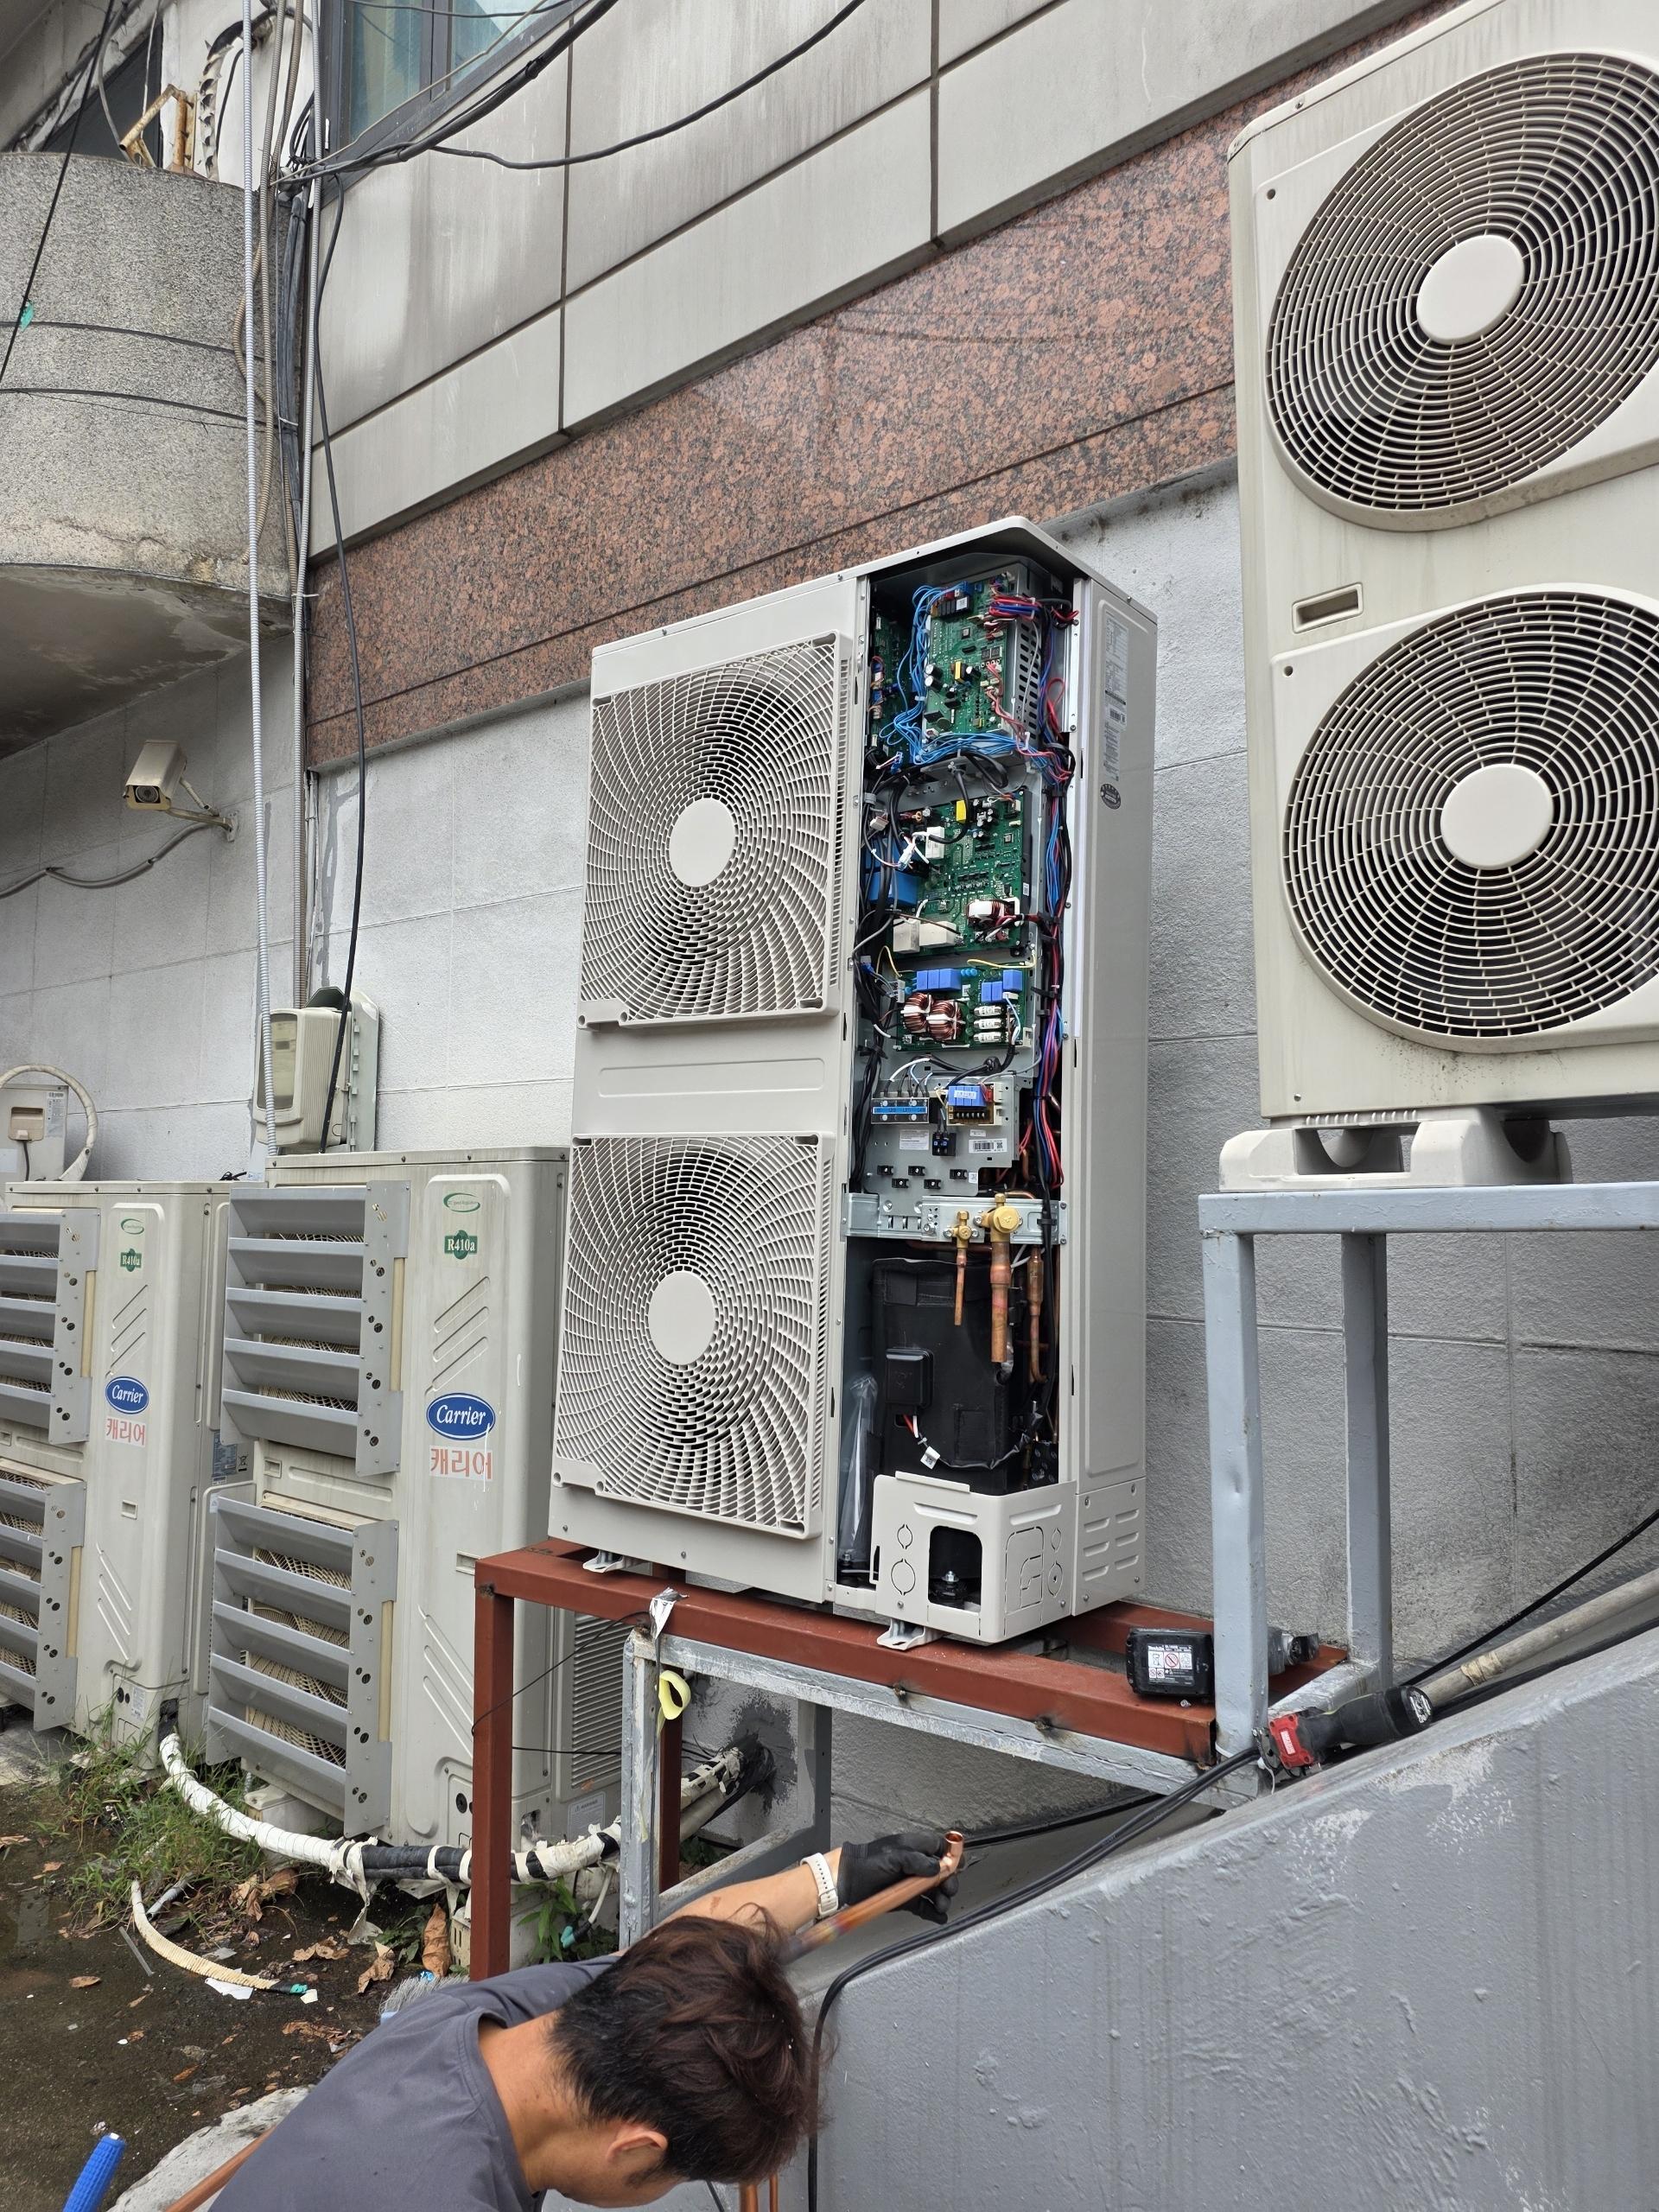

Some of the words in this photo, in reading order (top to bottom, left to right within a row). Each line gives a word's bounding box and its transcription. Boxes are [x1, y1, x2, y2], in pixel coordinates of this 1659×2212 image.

[448, 1238, 475, 1251] R410a
[111, 1384, 143, 1403] Carrier
[436, 1404, 486, 1425] Carrier
[106, 1418, 145, 1446] 캐리어
[430, 1448, 492, 1479] 캐리어
